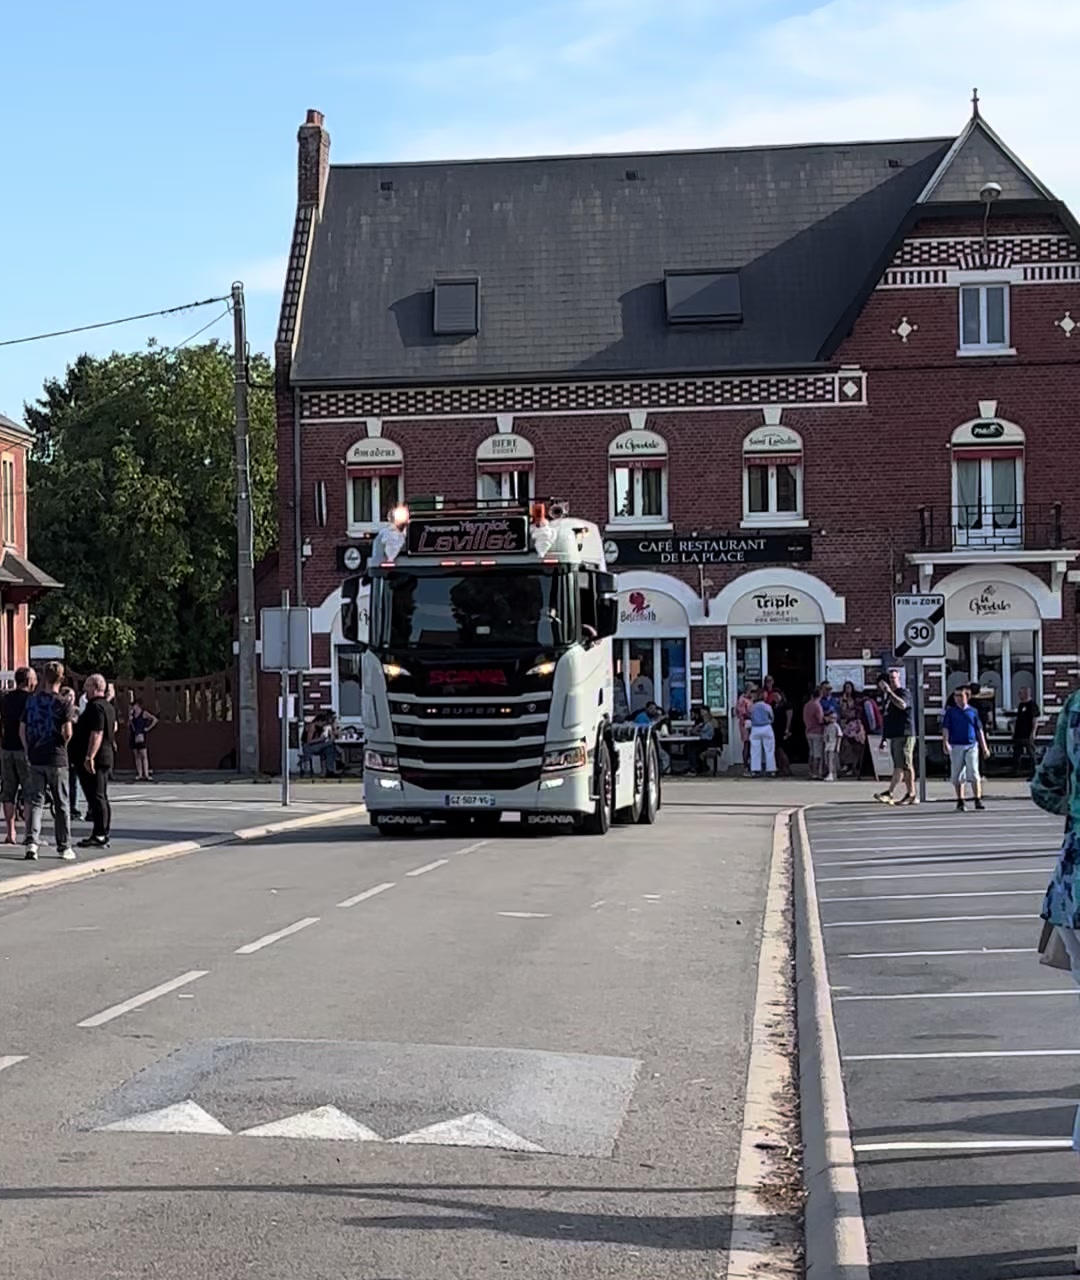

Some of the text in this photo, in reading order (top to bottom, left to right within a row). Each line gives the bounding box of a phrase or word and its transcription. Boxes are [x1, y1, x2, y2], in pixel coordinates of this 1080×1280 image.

[638, 538, 767, 552] CAFÉ RESTAURANT
[660, 551, 745, 563] DE LA PLACE
[752, 593, 799, 610] Triple
[897, 598, 910, 606] FIN
[909, 625, 930, 640] 30
[428, 669, 508, 685] SCANIA
[377, 815, 423, 824] SCANIA
[527, 815, 575, 824] SCANIA
